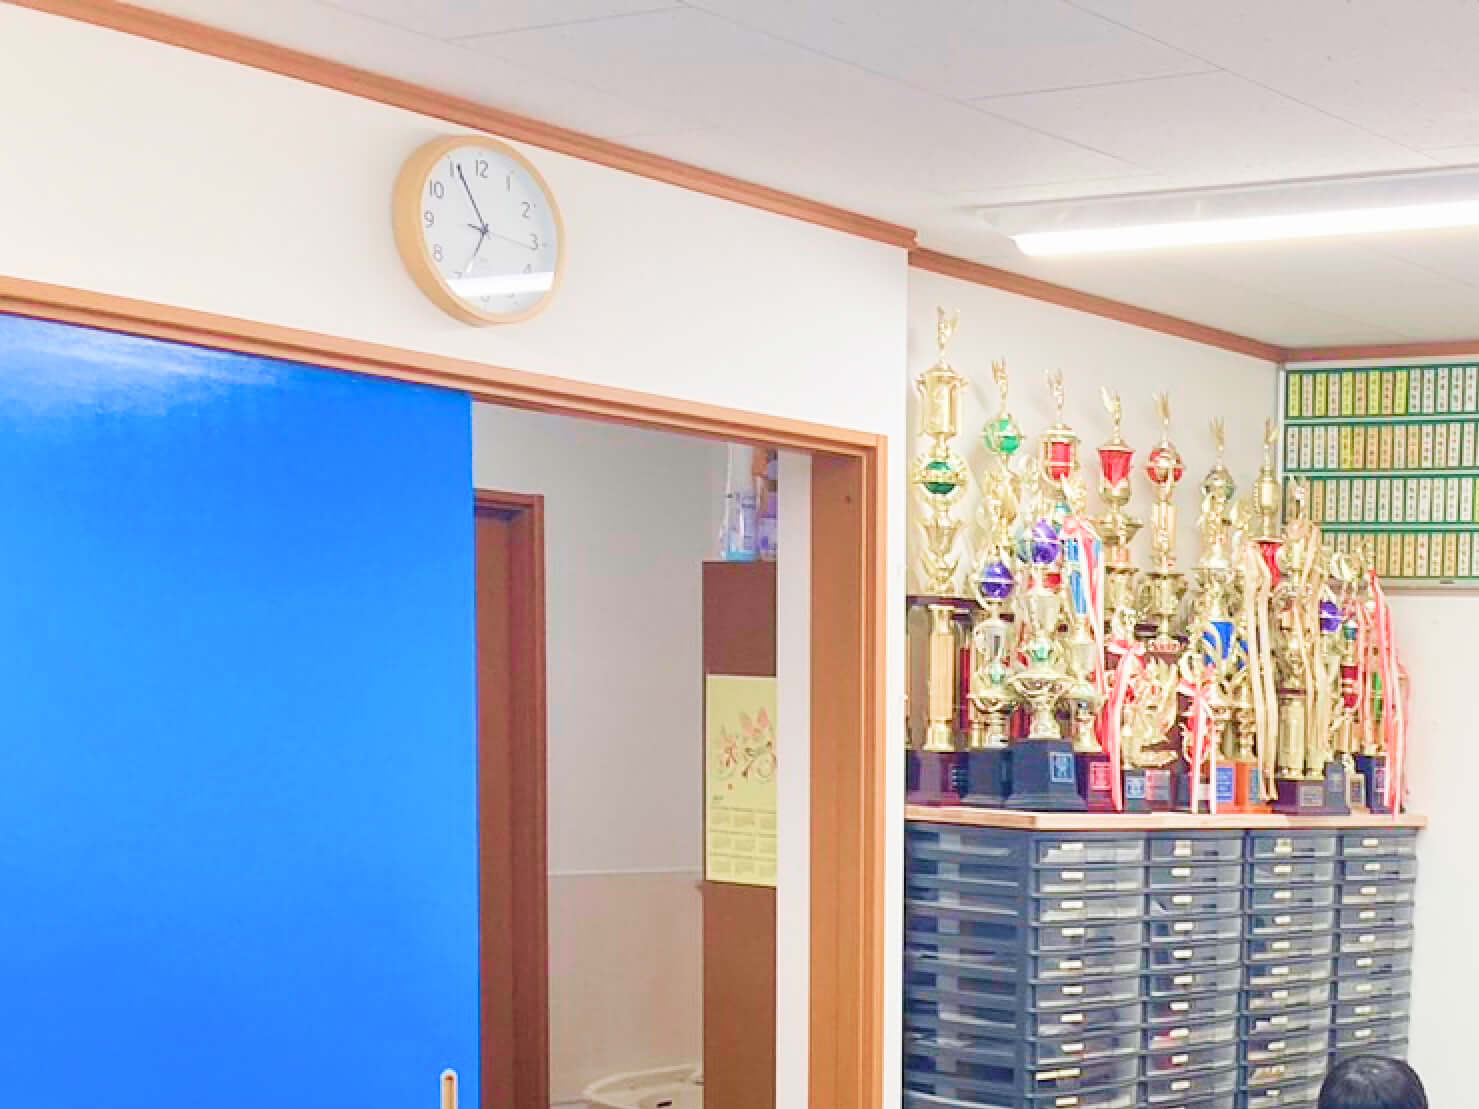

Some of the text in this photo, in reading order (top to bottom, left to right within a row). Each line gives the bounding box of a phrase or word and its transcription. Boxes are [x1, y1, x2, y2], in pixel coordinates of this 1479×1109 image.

[475, 159, 489, 179] 12
[428, 180, 445, 199] 10
[423, 209, 435, 228] 9
[520, 201, 531, 219] 2
[529, 233, 539, 251] 3
[432, 243, 444, 262] 8
